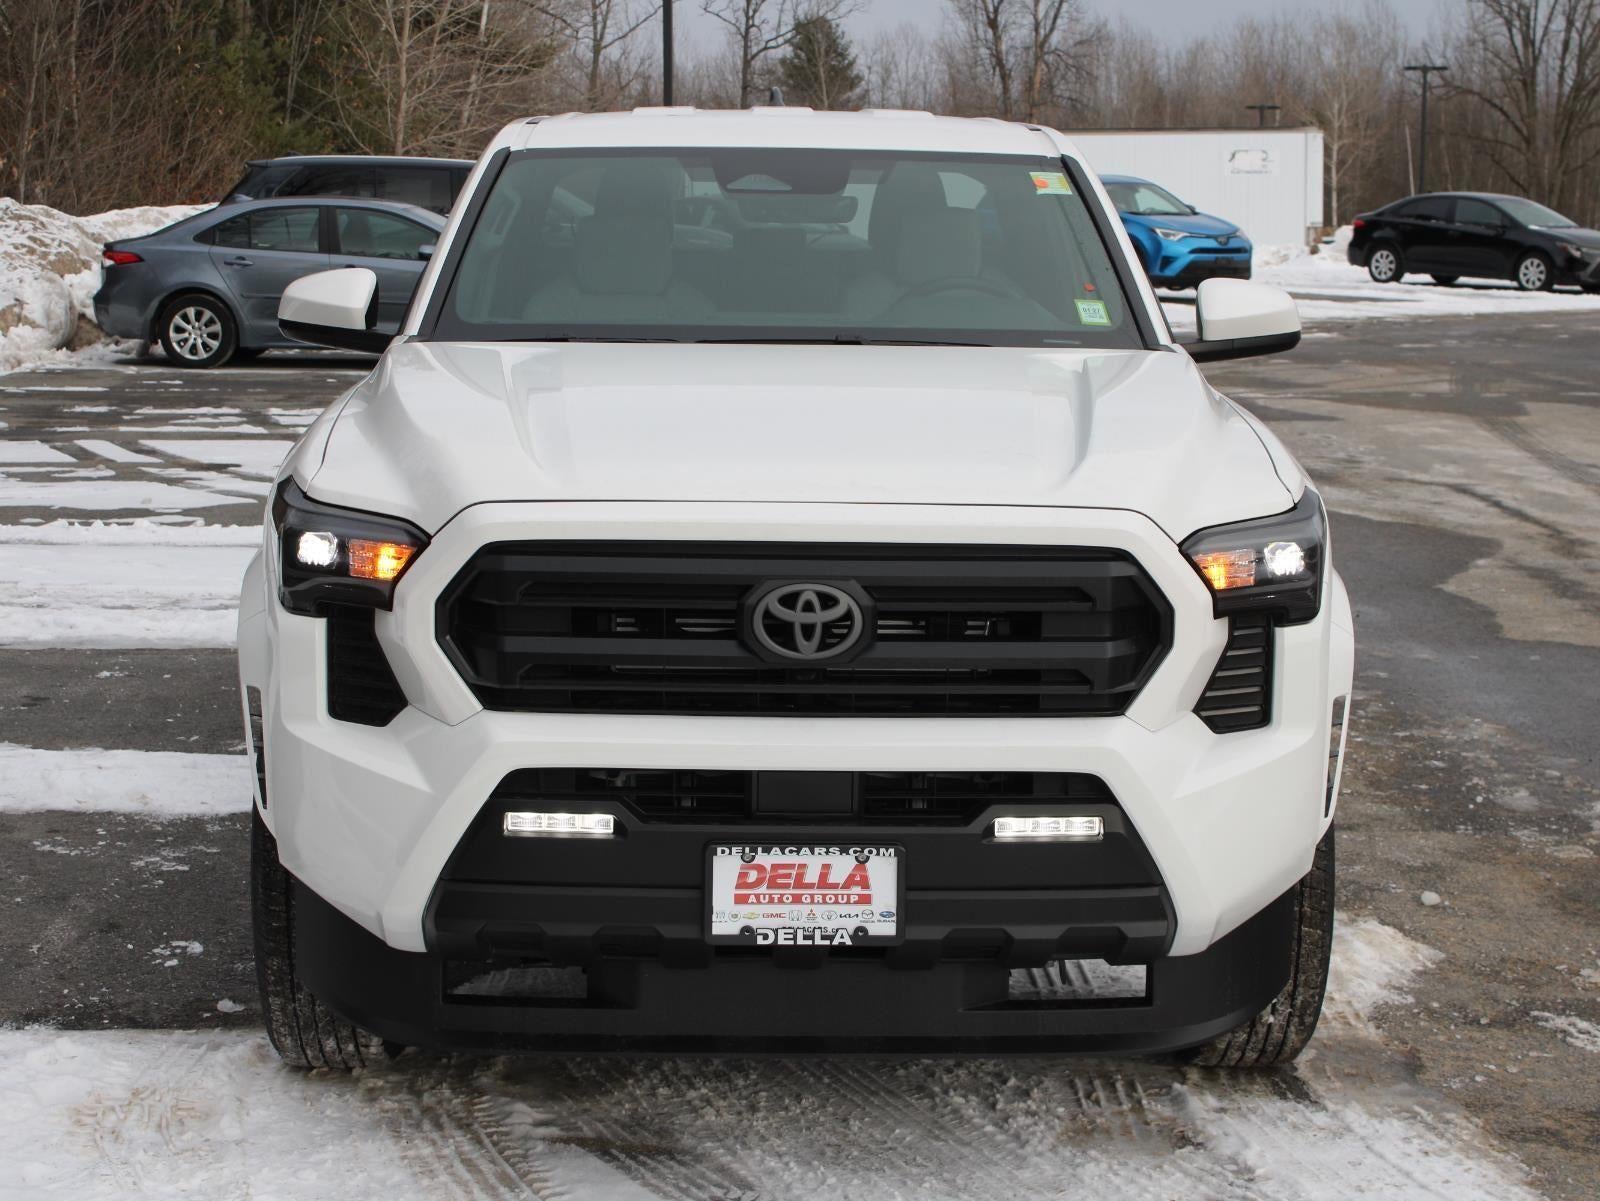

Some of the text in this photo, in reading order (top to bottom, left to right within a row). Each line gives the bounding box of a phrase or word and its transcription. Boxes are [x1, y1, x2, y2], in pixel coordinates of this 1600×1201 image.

[716, 847, 895, 856] DELLACARS.COM
[735, 863, 871, 890] DELLA
[748, 894, 859, 904] AUTO GROUP
[756, 928, 853, 945] DELLA
